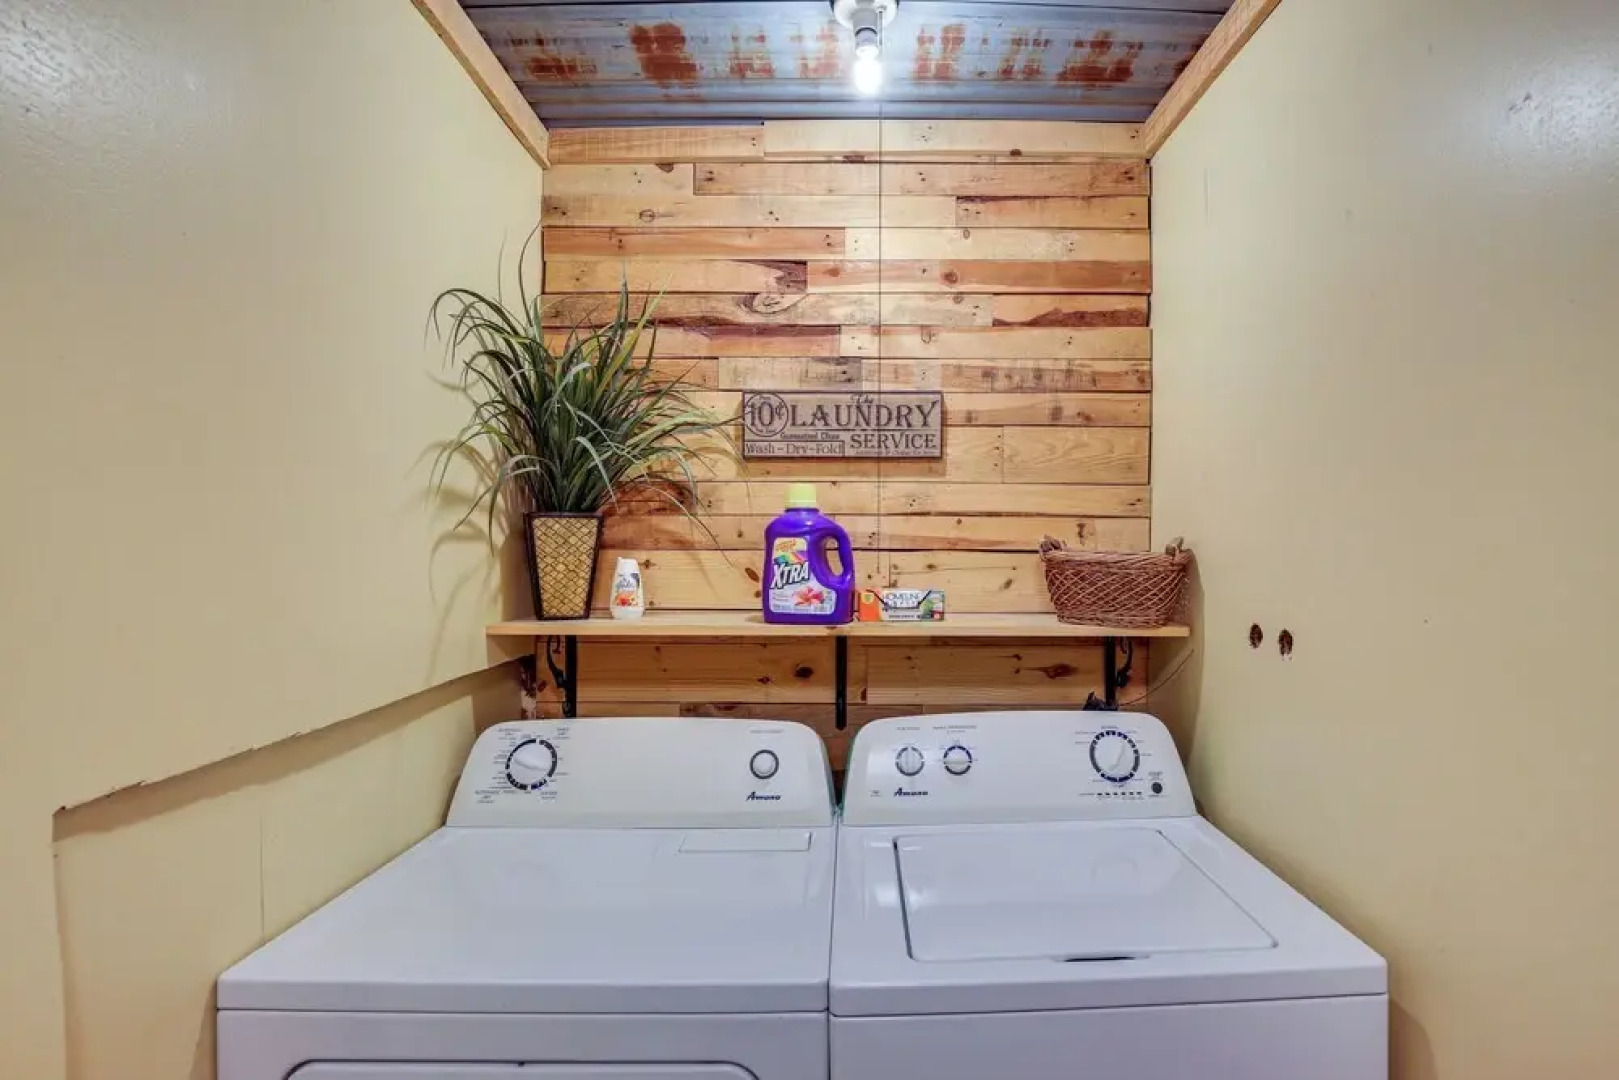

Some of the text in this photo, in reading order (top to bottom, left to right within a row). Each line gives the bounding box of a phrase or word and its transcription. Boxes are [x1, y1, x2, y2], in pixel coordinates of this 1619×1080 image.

[789, 399, 940, 428] LAUNDRY
[850, 431, 937, 450] SERVICE
[770, 561, 810, 590] XTRA
